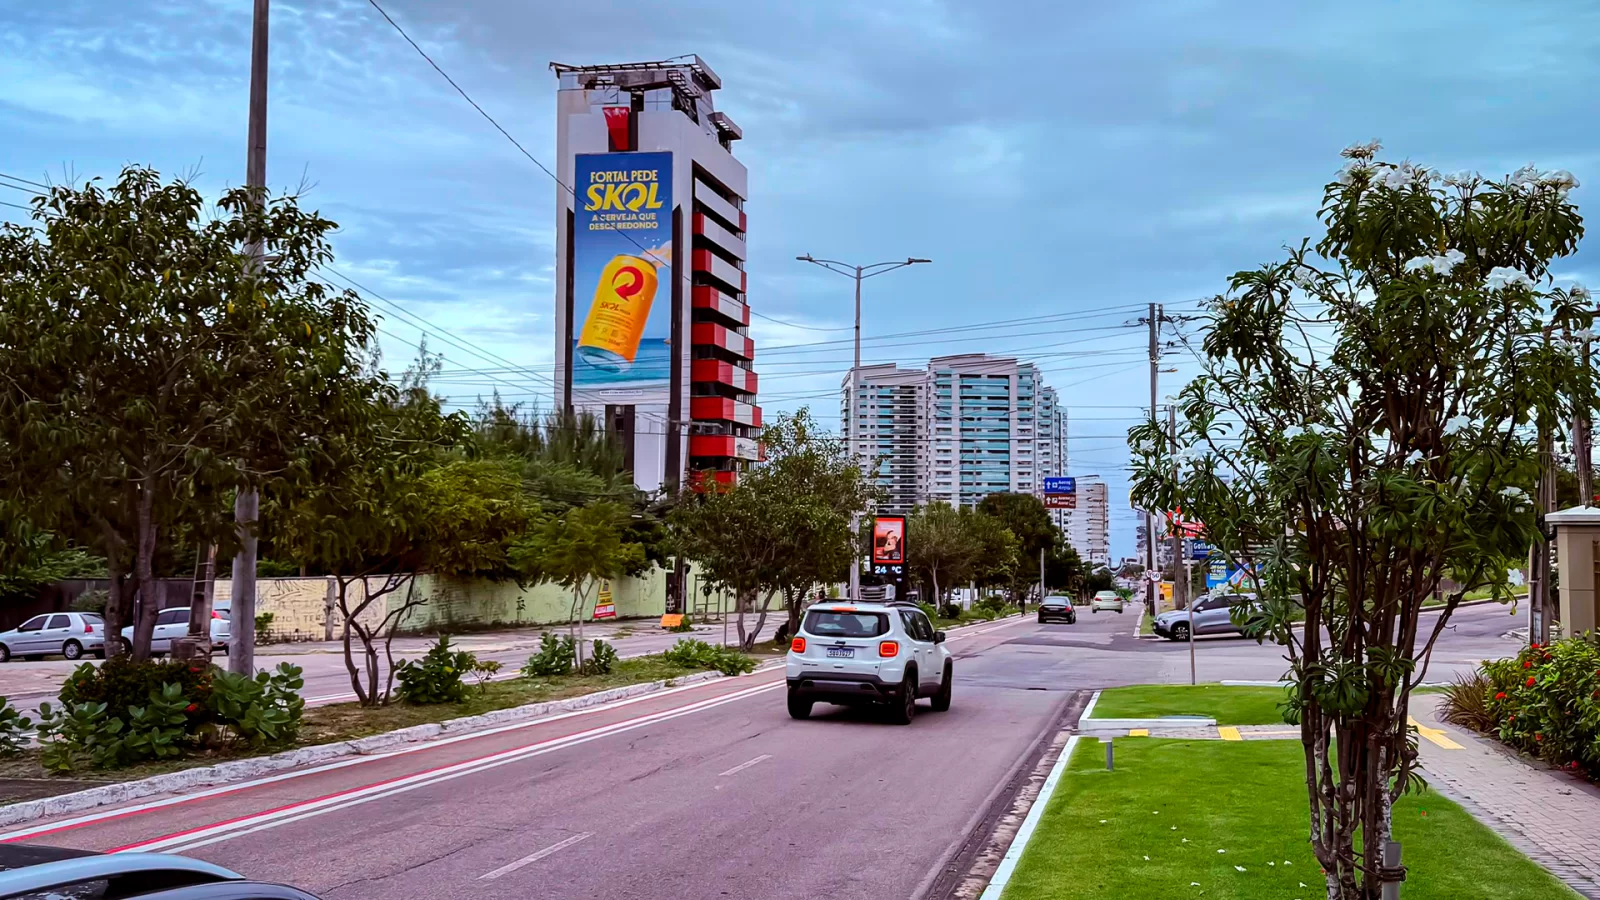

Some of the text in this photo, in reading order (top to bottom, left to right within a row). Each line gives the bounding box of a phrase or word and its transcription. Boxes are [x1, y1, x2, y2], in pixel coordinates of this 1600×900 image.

[590, 170, 658, 183] FORTAL PEDE
[584, 182, 663, 212] SKOL
[600, 213, 638, 221] CERVEJA
[638, 212, 656, 220] QUE
[617, 221, 658, 230] REDONDO
[875, 566, 887, 574] 24
